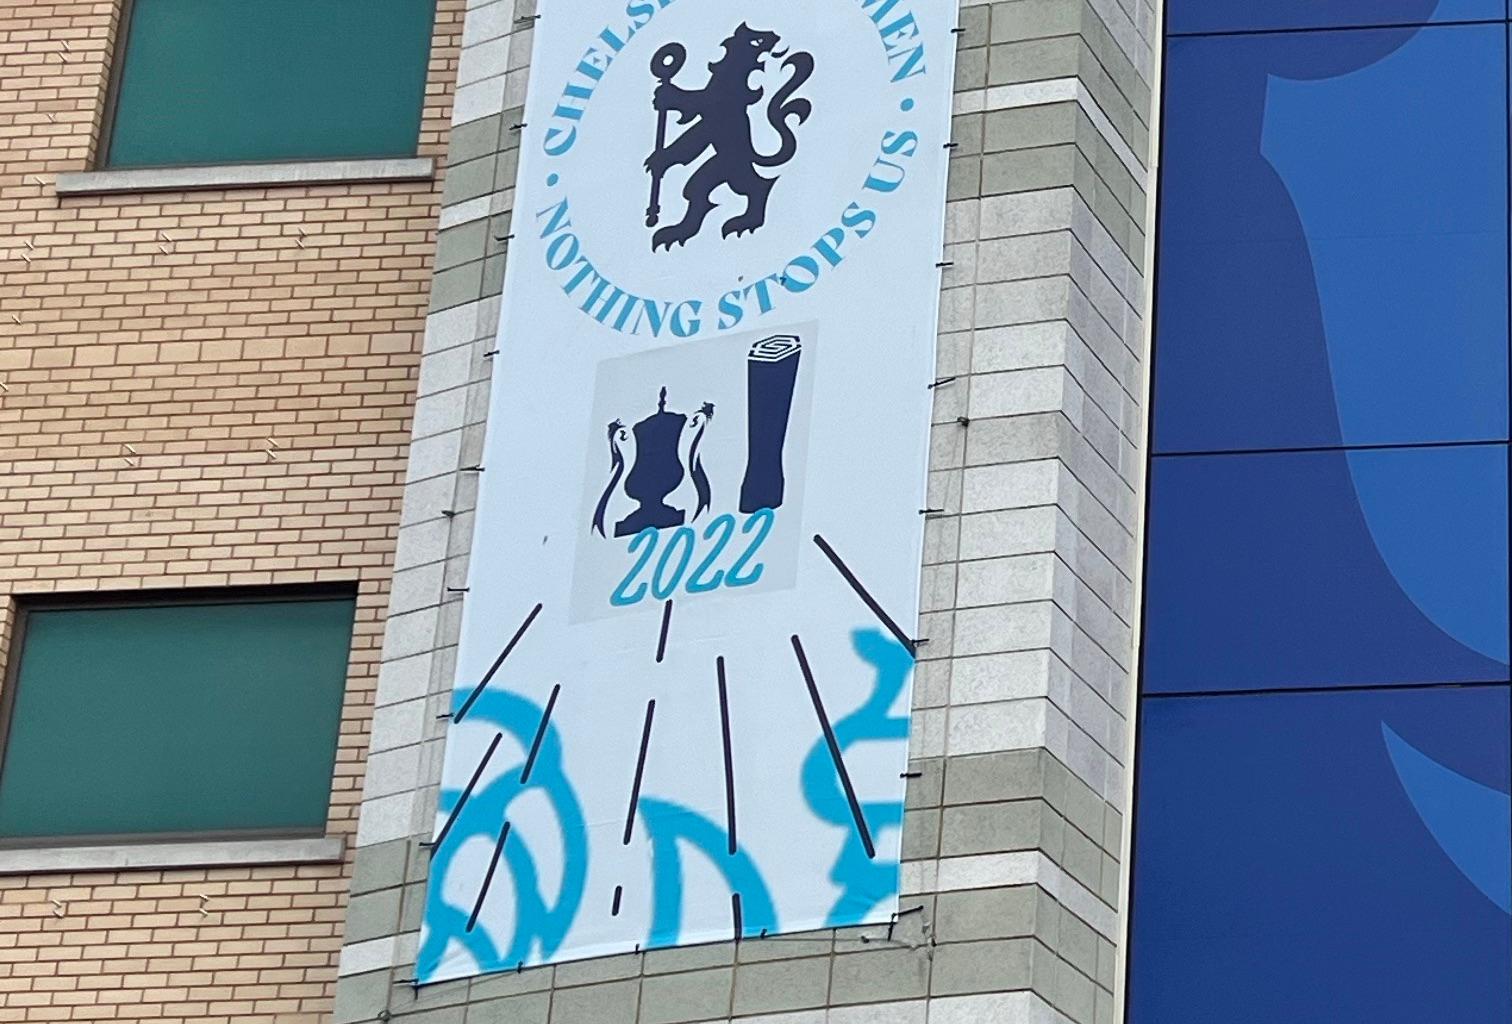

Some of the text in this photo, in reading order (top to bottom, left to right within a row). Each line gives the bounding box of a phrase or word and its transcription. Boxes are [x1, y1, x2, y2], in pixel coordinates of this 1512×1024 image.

[543, 0, 674, 157] CHELS
[535, 130, 919, 338] NOTHING STOPS US
[610, 506, 777, 608] 2022
